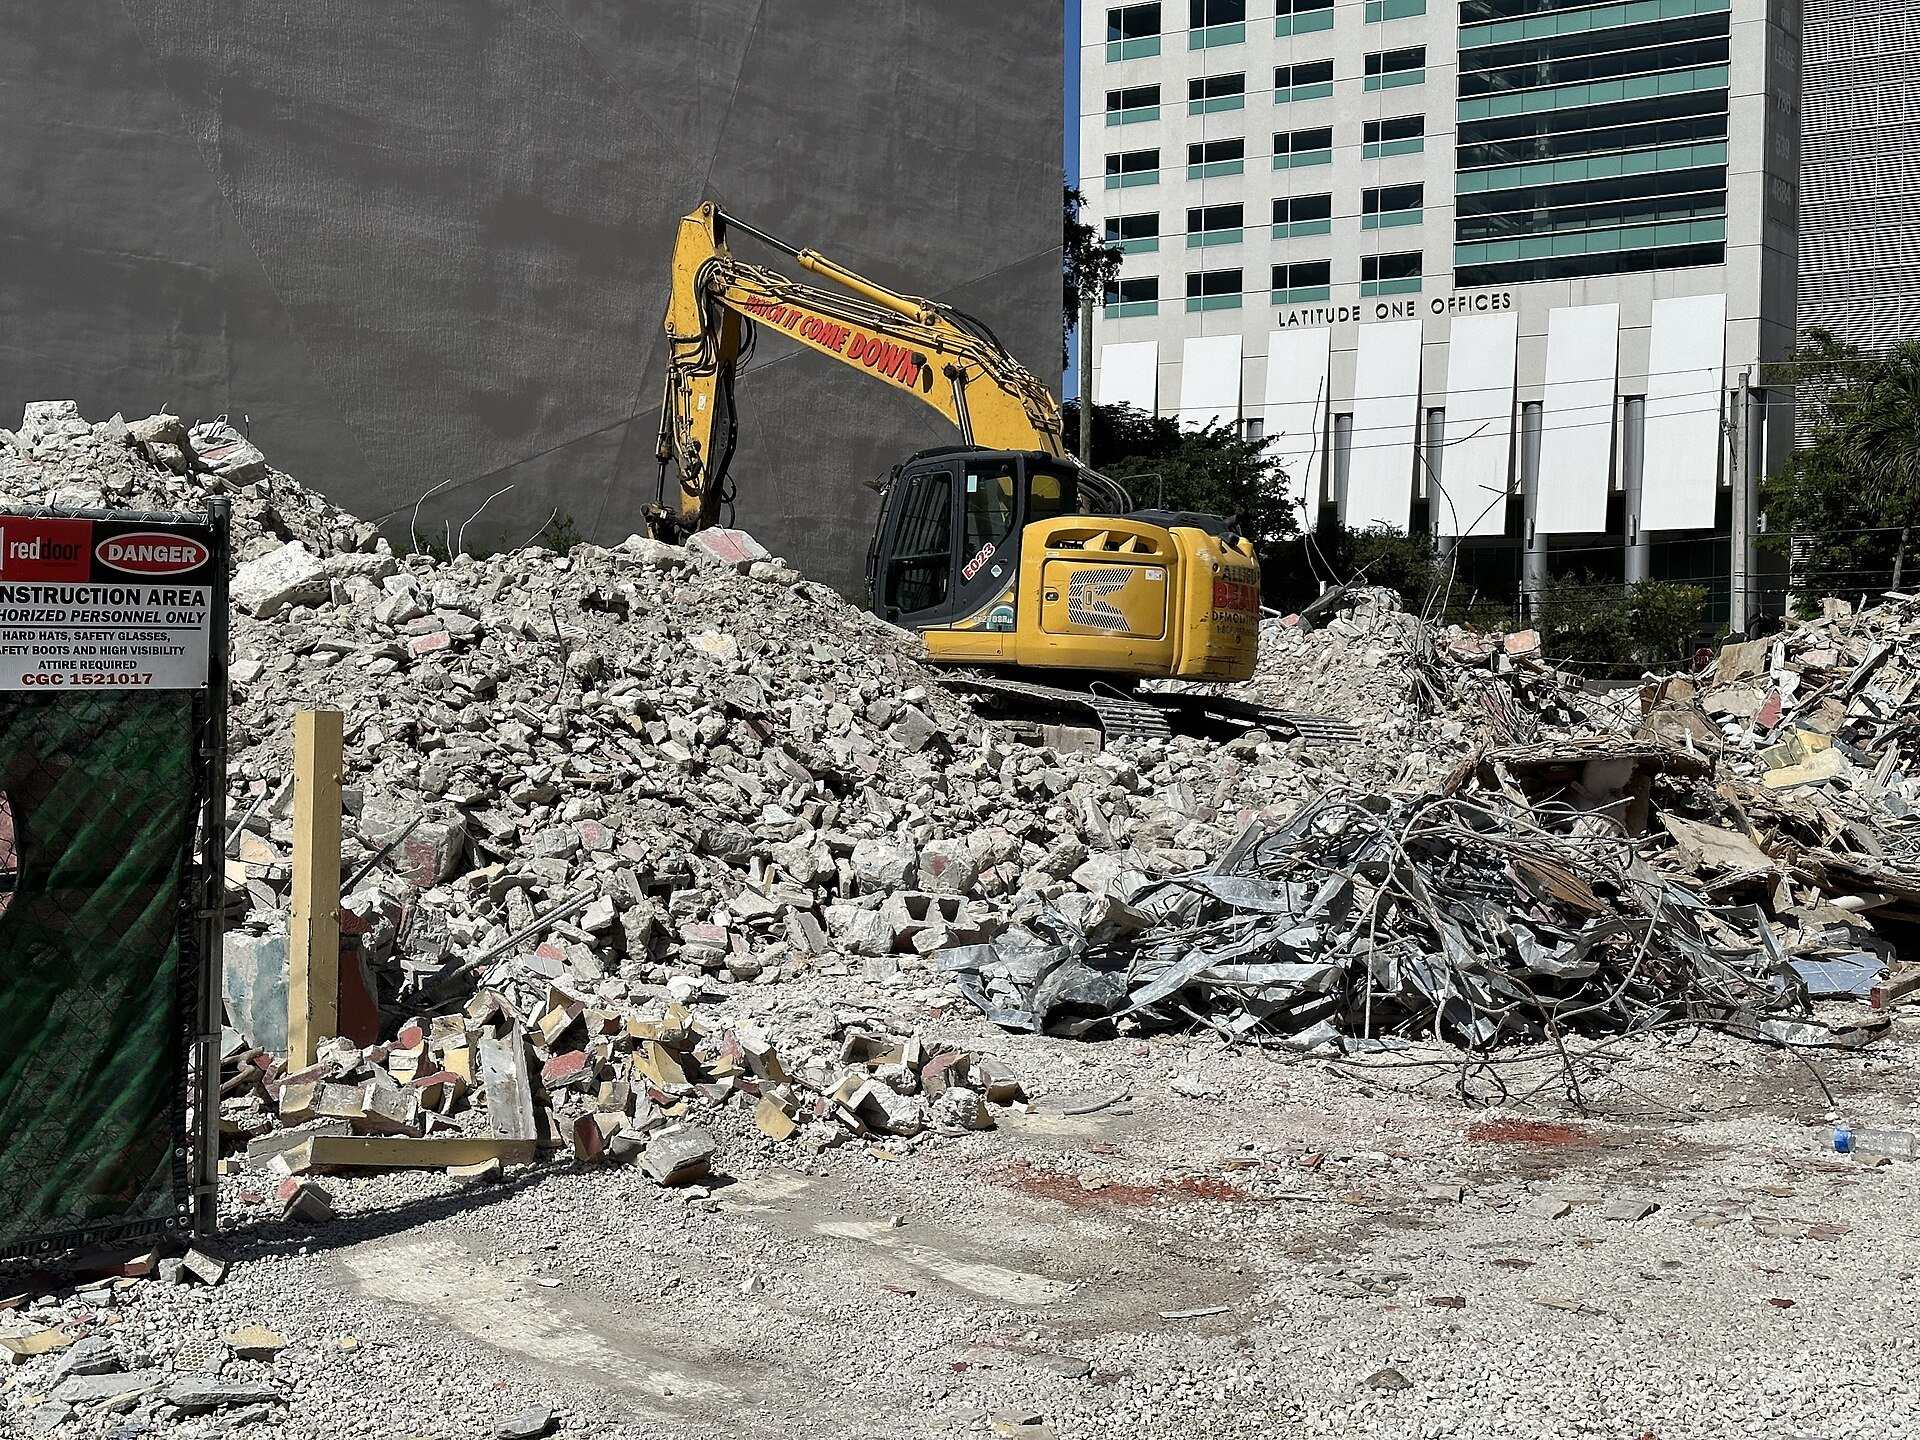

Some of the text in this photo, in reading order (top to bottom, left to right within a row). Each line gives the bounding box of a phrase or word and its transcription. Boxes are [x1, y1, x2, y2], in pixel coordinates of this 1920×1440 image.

[1278, 292, 1511, 328] LATITUDE ONE OFFICES
[744, 294, 923, 389] WATCH IT COME DOWN
[108, 543, 198, 564] DANGER
[0, 585, 207, 607] NSTRUCTION AREA
[71, 609, 162, 624] PERSONNEL
[165, 611, 207, 624] ONLY
[2, 630, 171, 643] HARD HATS, SAFETY GLASSES,
[0, 645, 186, 656] FETY BOOTS AND HIGH VISIBILITY
[38, 660, 138, 671] ATTIRE REQUIRED
[21, 673, 153, 686] CGC 1521017
